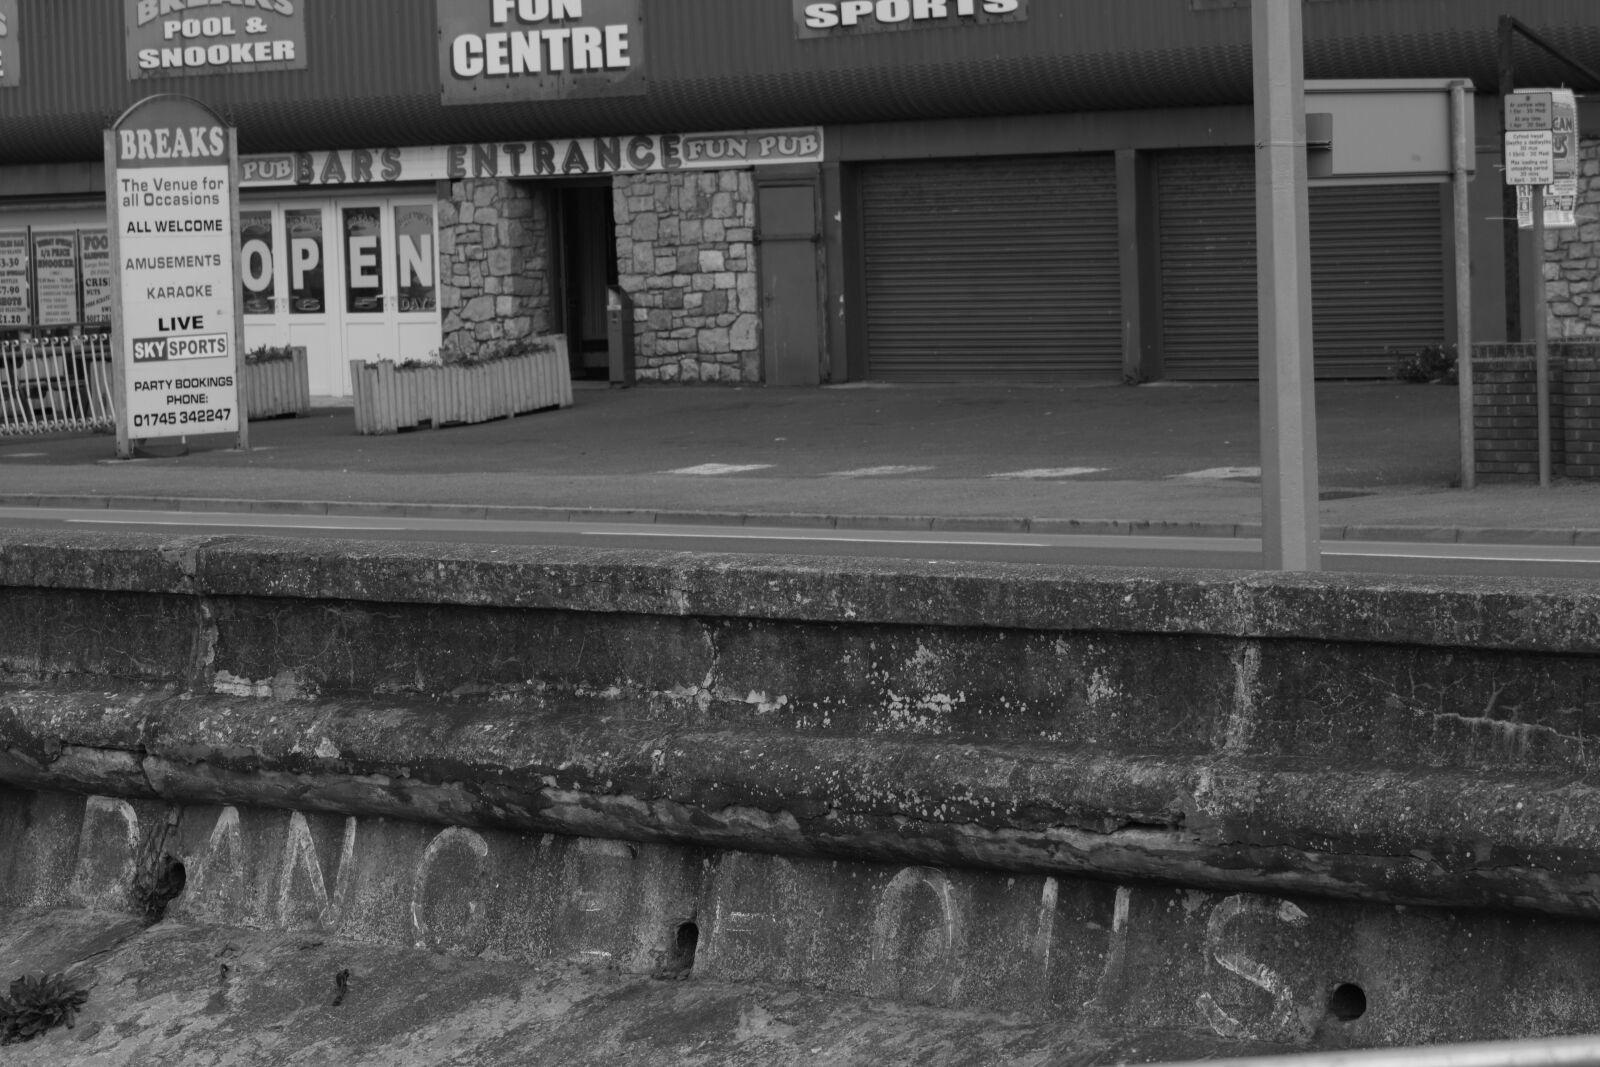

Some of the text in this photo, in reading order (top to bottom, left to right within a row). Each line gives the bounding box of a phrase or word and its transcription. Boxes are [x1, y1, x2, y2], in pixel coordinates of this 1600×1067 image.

[164, 17, 267, 39] POOL &
[138, 40, 295, 69] SNOOKER
[453, 24, 631, 77] CENTRE
[119, 126, 224, 160] BREAKS
[687, 134, 818, 160] FUN PUB
[447, 134, 683, 178] ENTRANCE
[243, 160, 291, 180] PUB
[121, 176, 224, 192] The Venue for
[122, 192, 220, 207] all Occasions
[126, 219, 223, 233] ALL WELCOME
[83, 236, 109, 250] POO
[126, 254, 221, 270] AMUSEMENTS
[241, 234, 433, 292] OPEN
[147, 285, 212, 299] KARAOKE
[158, 316, 204, 331] LIVE
[135, 338, 226, 359] SKY SPORTS
[134, 376, 233, 391] PARTY BOOKINGS
[166, 394, 209, 405] PHONE:
[134, 408, 231, 427] 01745 342247
